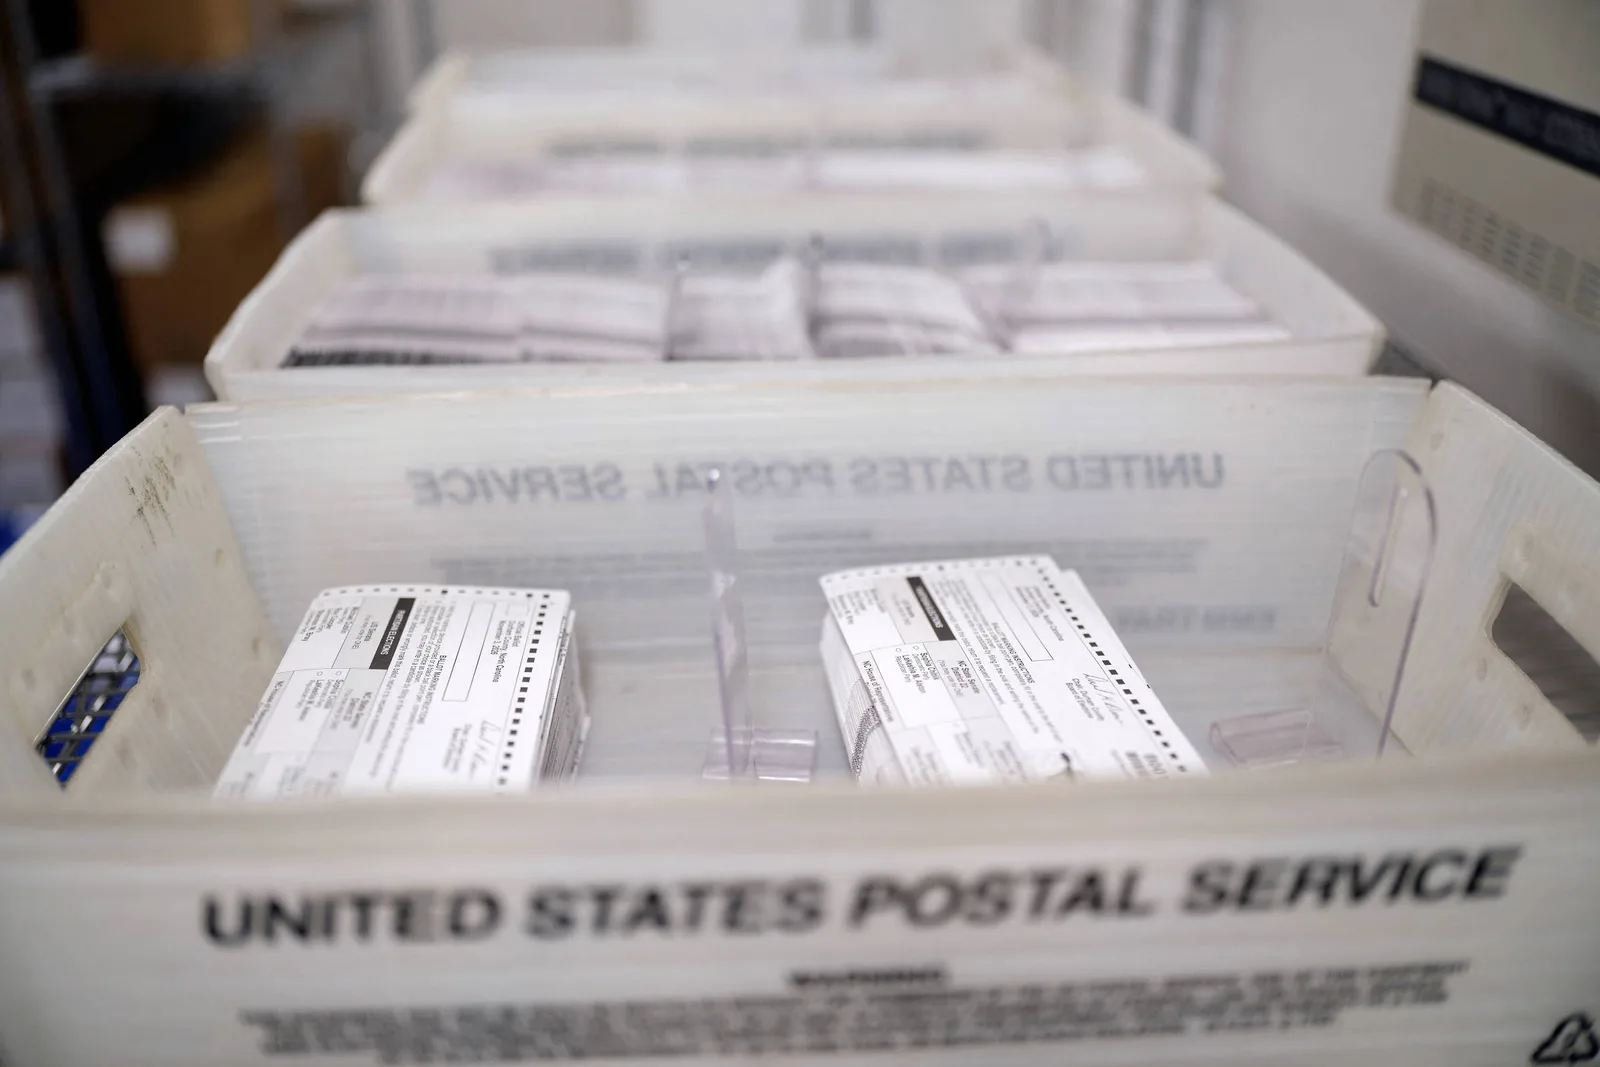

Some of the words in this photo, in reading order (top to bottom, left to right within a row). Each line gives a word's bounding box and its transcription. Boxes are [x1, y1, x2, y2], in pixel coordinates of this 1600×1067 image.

[363, 628, 376, 641] Senate
[378, 631, 397, 655] ELECTIONS
[429, 644, 441, 659] provided
[496, 652, 508, 664] North
[918, 652, 933, 666] Sophia
[434, 655, 447, 670] BALLOT
[901, 654, 918, 673] LaKeshia
[999, 637, 1017, 654] MARKING
[1011, 654, 1035, 683] INSTRUCTIONS
[491, 664, 504, 682] Carolina
[865, 667, 878, 682] House
[950, 666, 965, 682] District
[960, 667, 973, 678] State
[427, 671, 441, 691] MARKING
[966, 678, 982, 693] Senate
[201, 884, 502, 948] UNITED
[525, 877, 825, 938] STATES
[848, 866, 1157, 930] POSTAL
[1182, 845, 1522, 914] SERVICE
